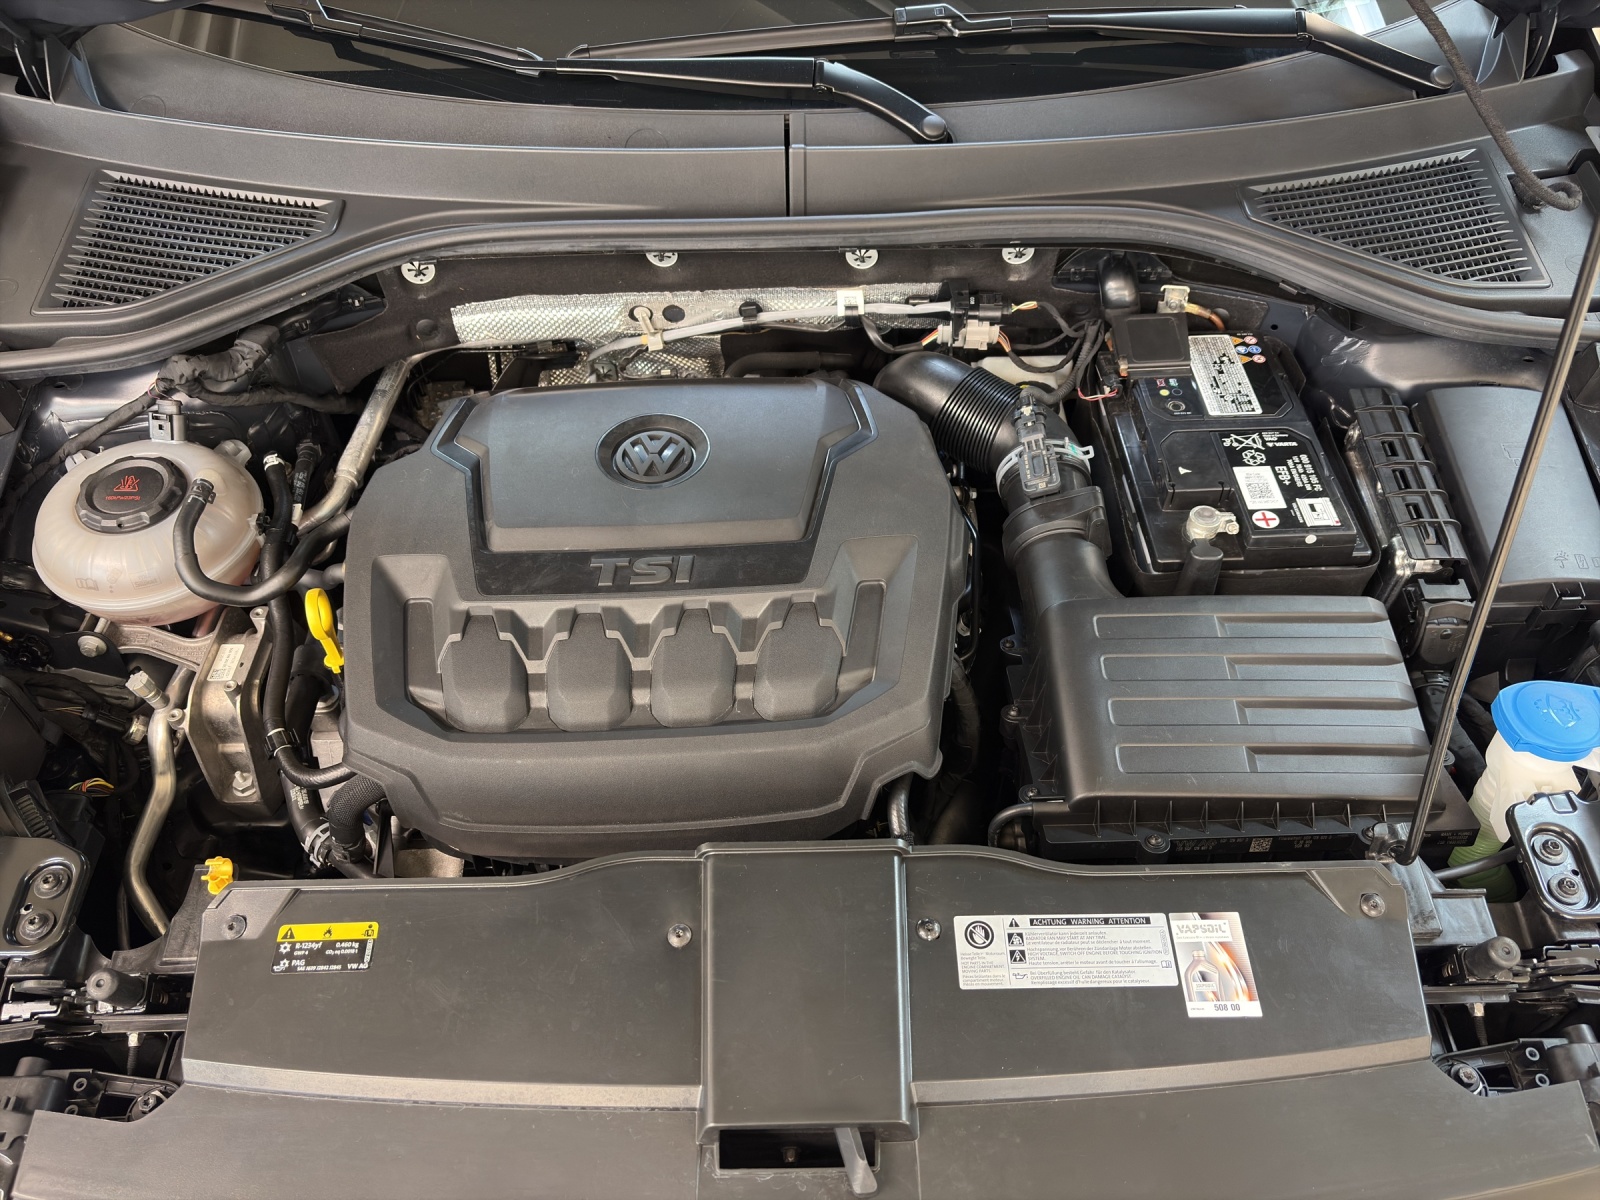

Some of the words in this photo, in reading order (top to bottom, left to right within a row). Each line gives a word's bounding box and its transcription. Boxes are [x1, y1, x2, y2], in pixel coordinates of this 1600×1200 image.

[1300, 454, 1310, 464] 000
[1275, 466, 1291, 486] EFB+
[590, 554, 696, 587] TSI
[295, 942, 322, 950] R-1234yf
